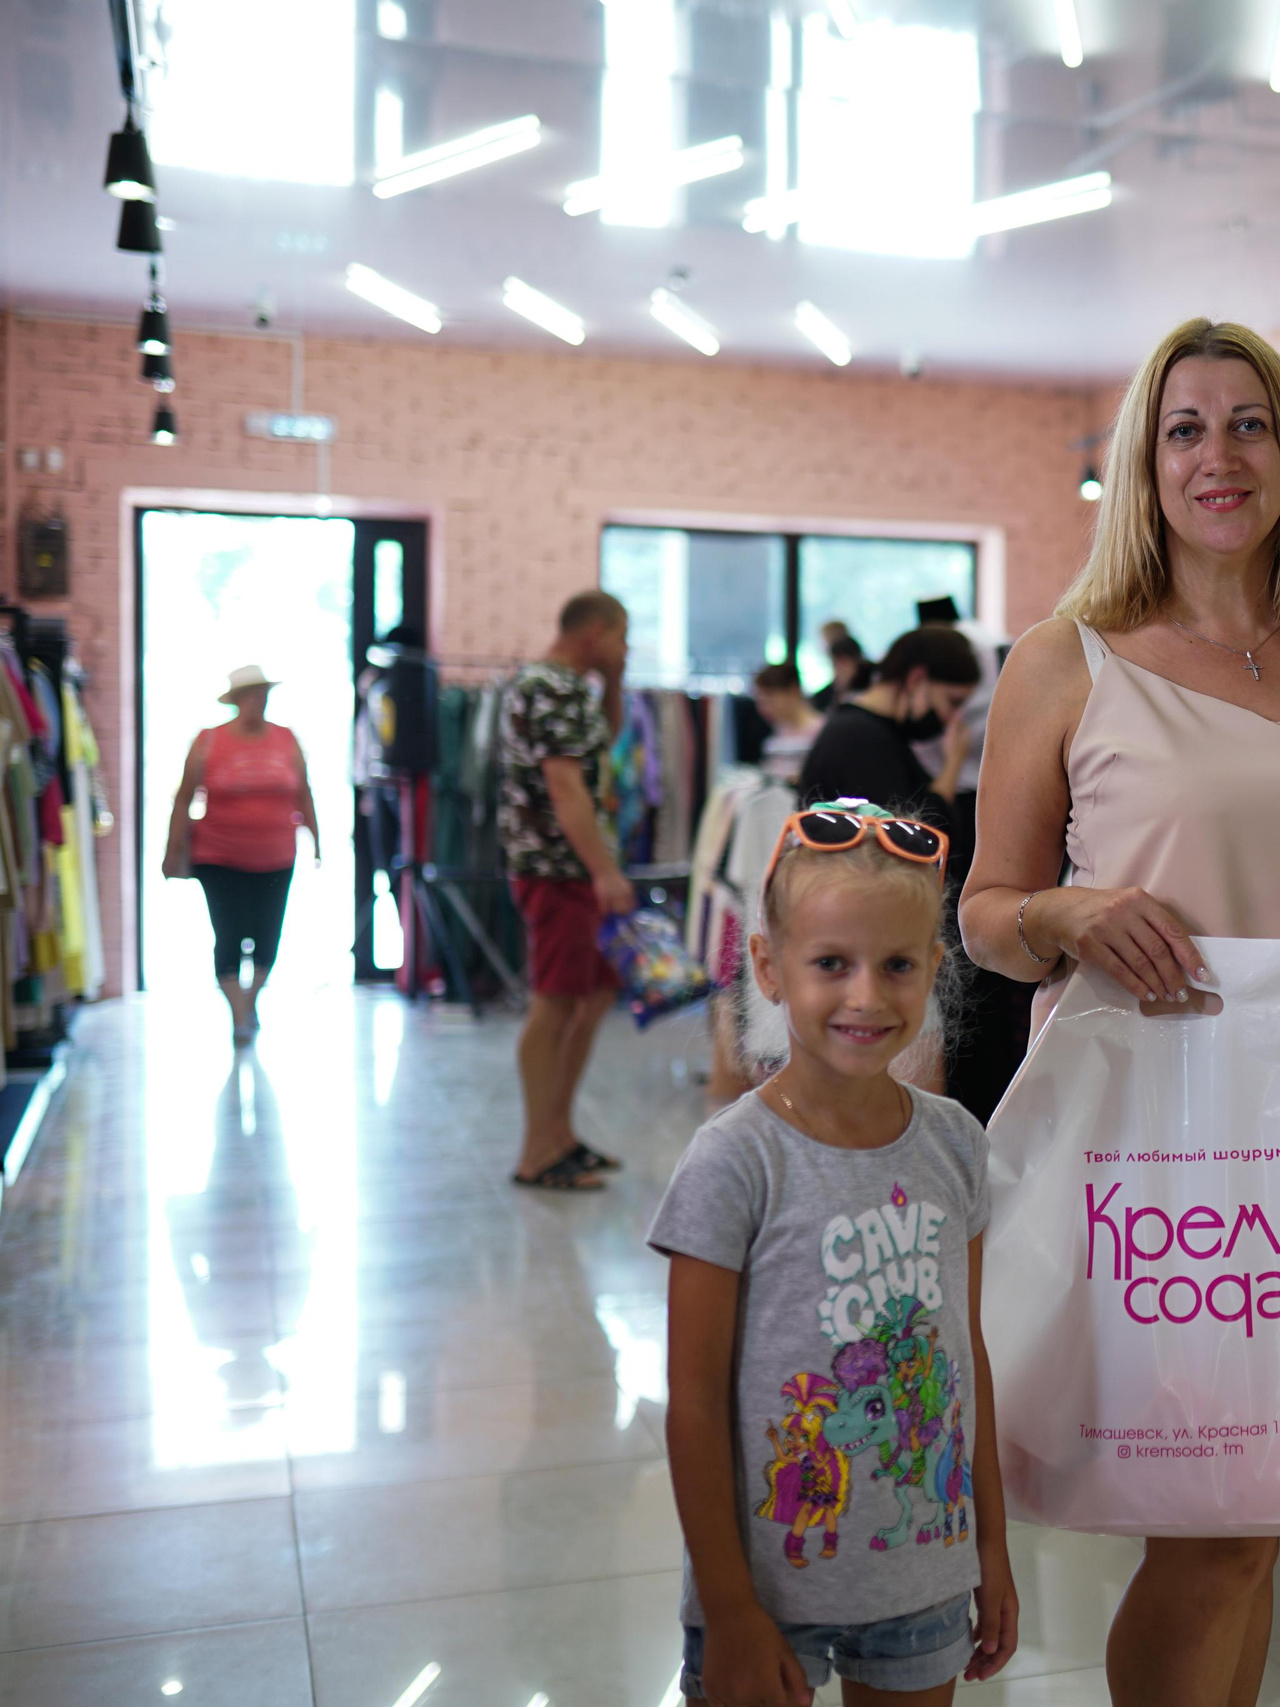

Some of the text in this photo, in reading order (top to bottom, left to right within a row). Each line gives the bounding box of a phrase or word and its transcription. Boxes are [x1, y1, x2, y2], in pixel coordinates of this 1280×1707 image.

[1083, 1150, 1121, 1164] Твой
[1126, 1149, 1206, 1163] любимый
[821, 1201, 948, 1283] CAVE
[1079, 1423, 1169, 1441] Тимашевск,
[1172, 1427, 1193, 1442] ул.
[1198, 1421, 1268, 1442] Красная
